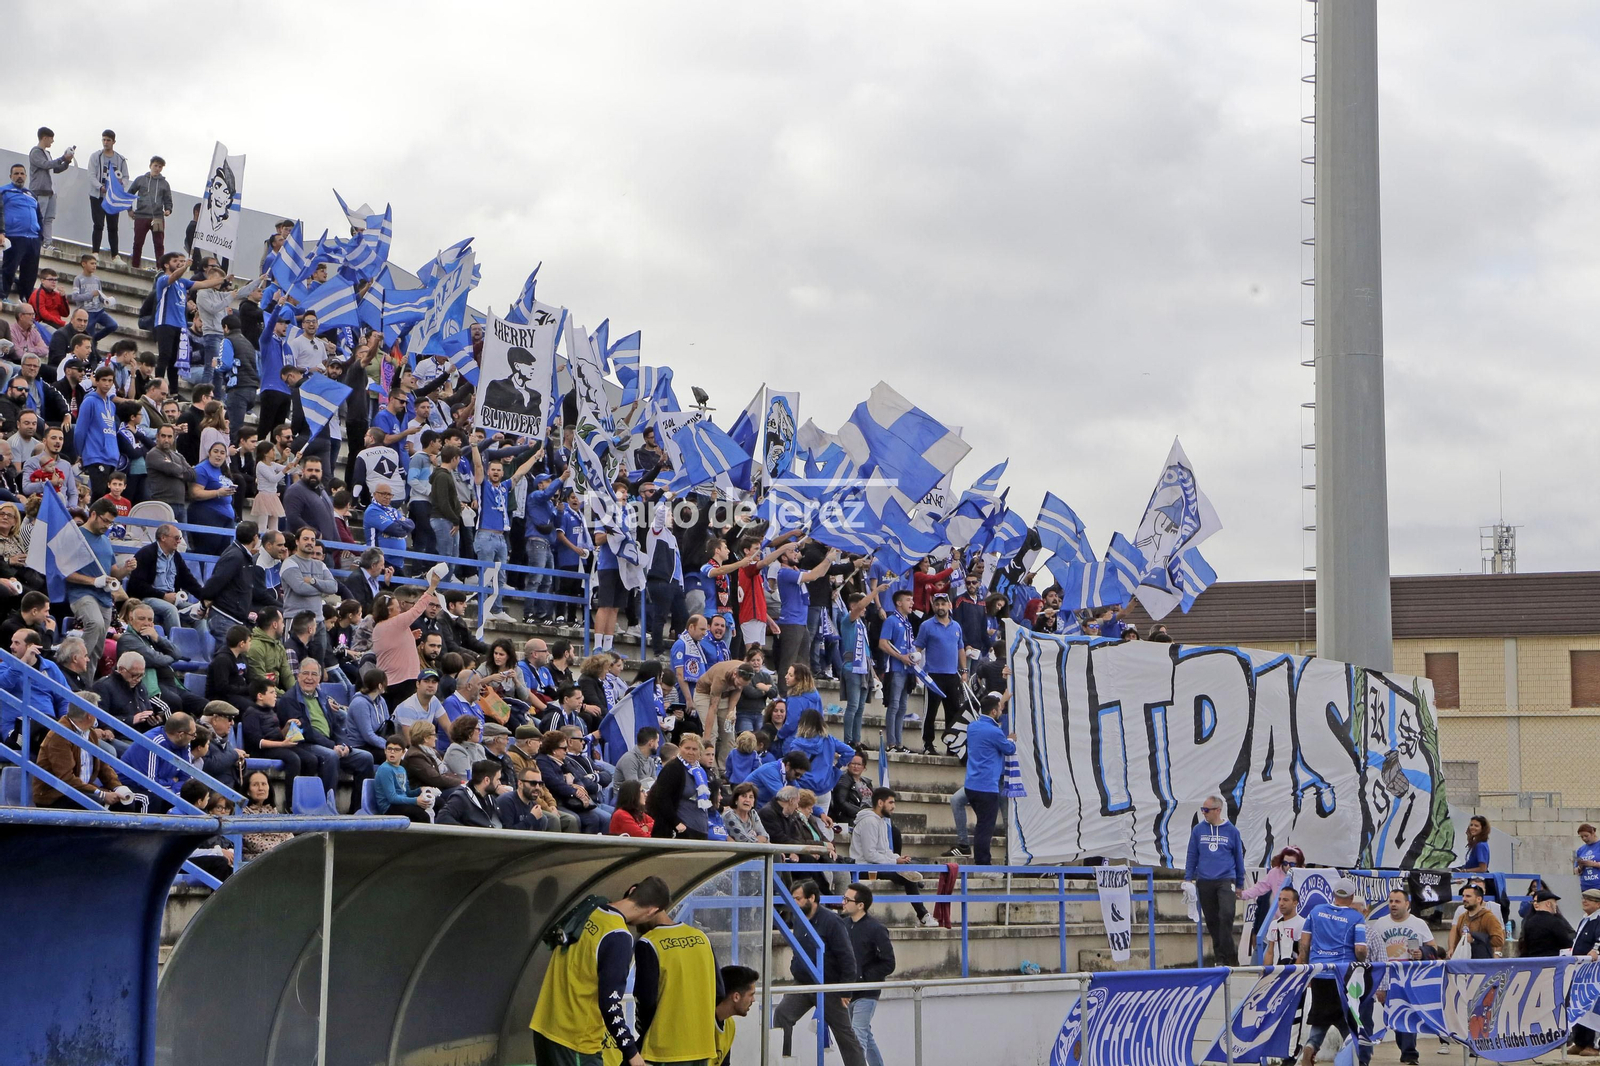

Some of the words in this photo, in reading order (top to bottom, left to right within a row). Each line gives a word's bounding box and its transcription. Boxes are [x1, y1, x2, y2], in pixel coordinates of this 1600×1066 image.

[481, 405, 542, 436] BLINDERS
[380, 459, 393, 475] 1
[854, 627, 864, 662] XEREZ
[1316, 877, 1324, 890] ES
[1110, 902, 1125, 923] &
[1331, 914, 1349, 923] FUTSAL
[659, 935, 705, 951] Kappa
[1474, 1037, 1495, 1052] contra
[1495, 1033, 1501, 1049] el
[1503, 1031, 1529, 1049] futbol
